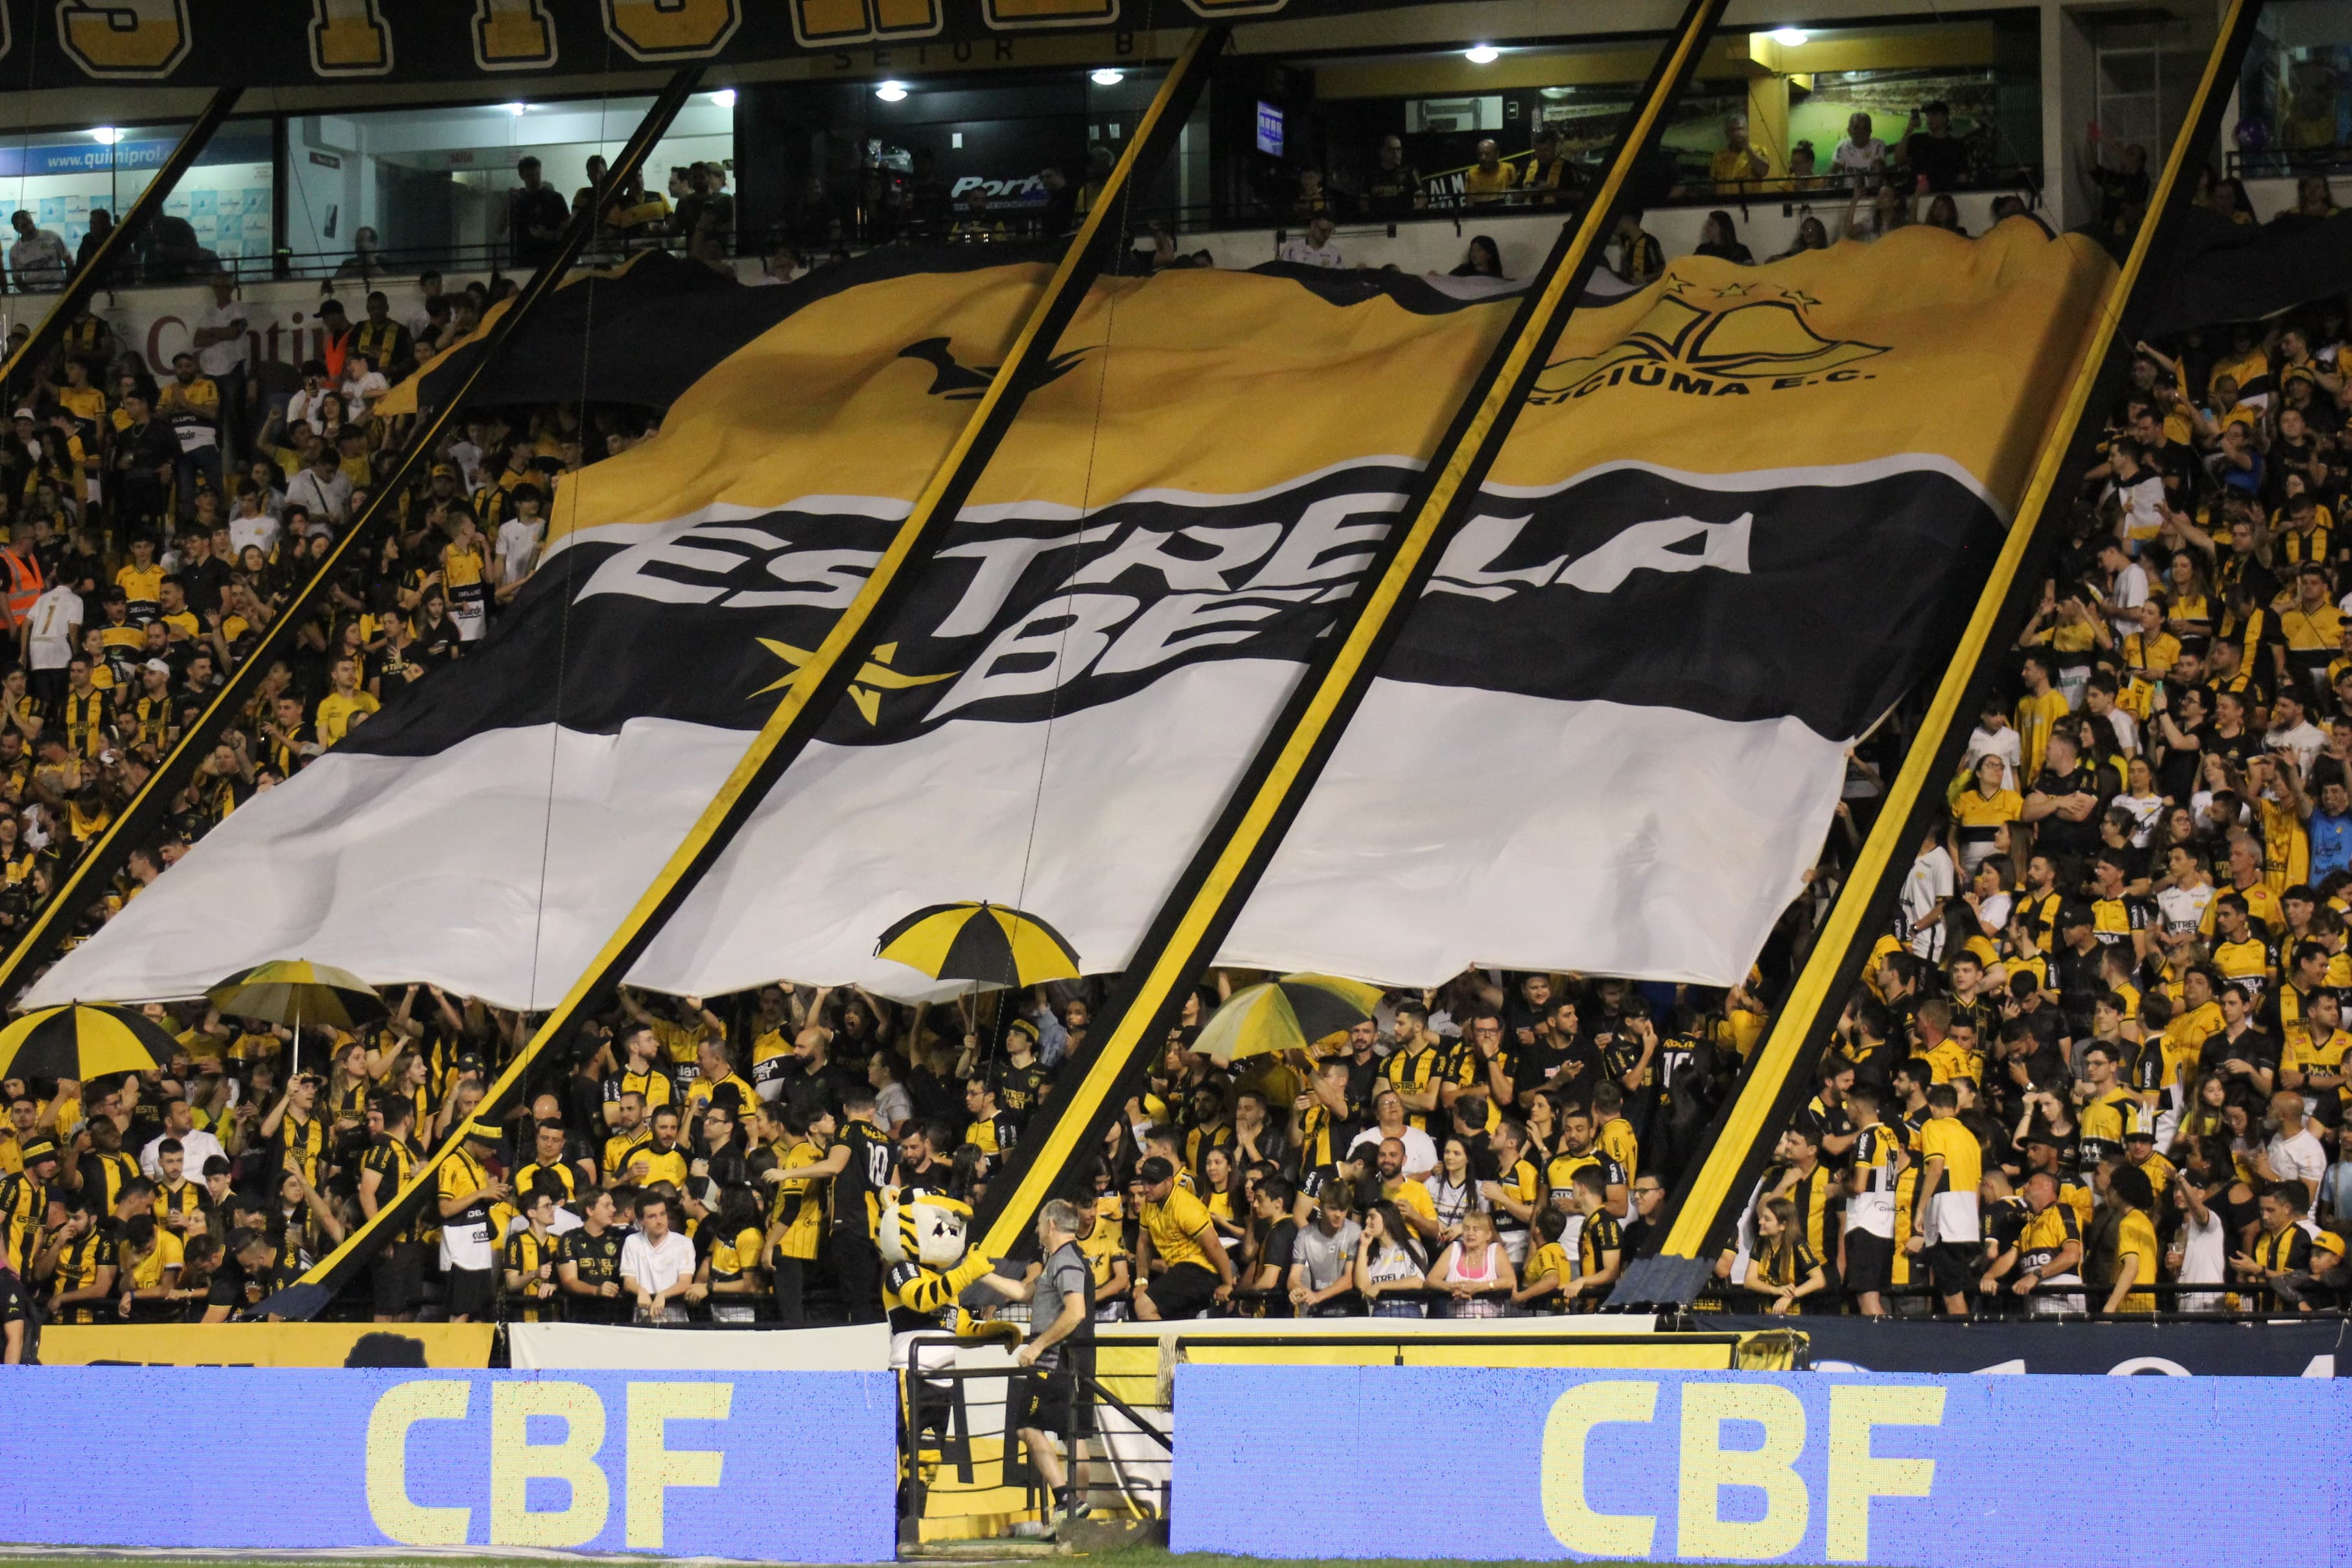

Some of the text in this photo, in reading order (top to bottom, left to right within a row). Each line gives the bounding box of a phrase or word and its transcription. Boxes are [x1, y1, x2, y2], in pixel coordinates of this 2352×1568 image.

[41, 605, 56, 635] 1
[572, 491, 1754, 638] ESTRELA
[867, 1140, 889, 1187] 10
[365, 1379, 734, 1550] CBF
[1541, 1380, 1948, 1562] CBF
